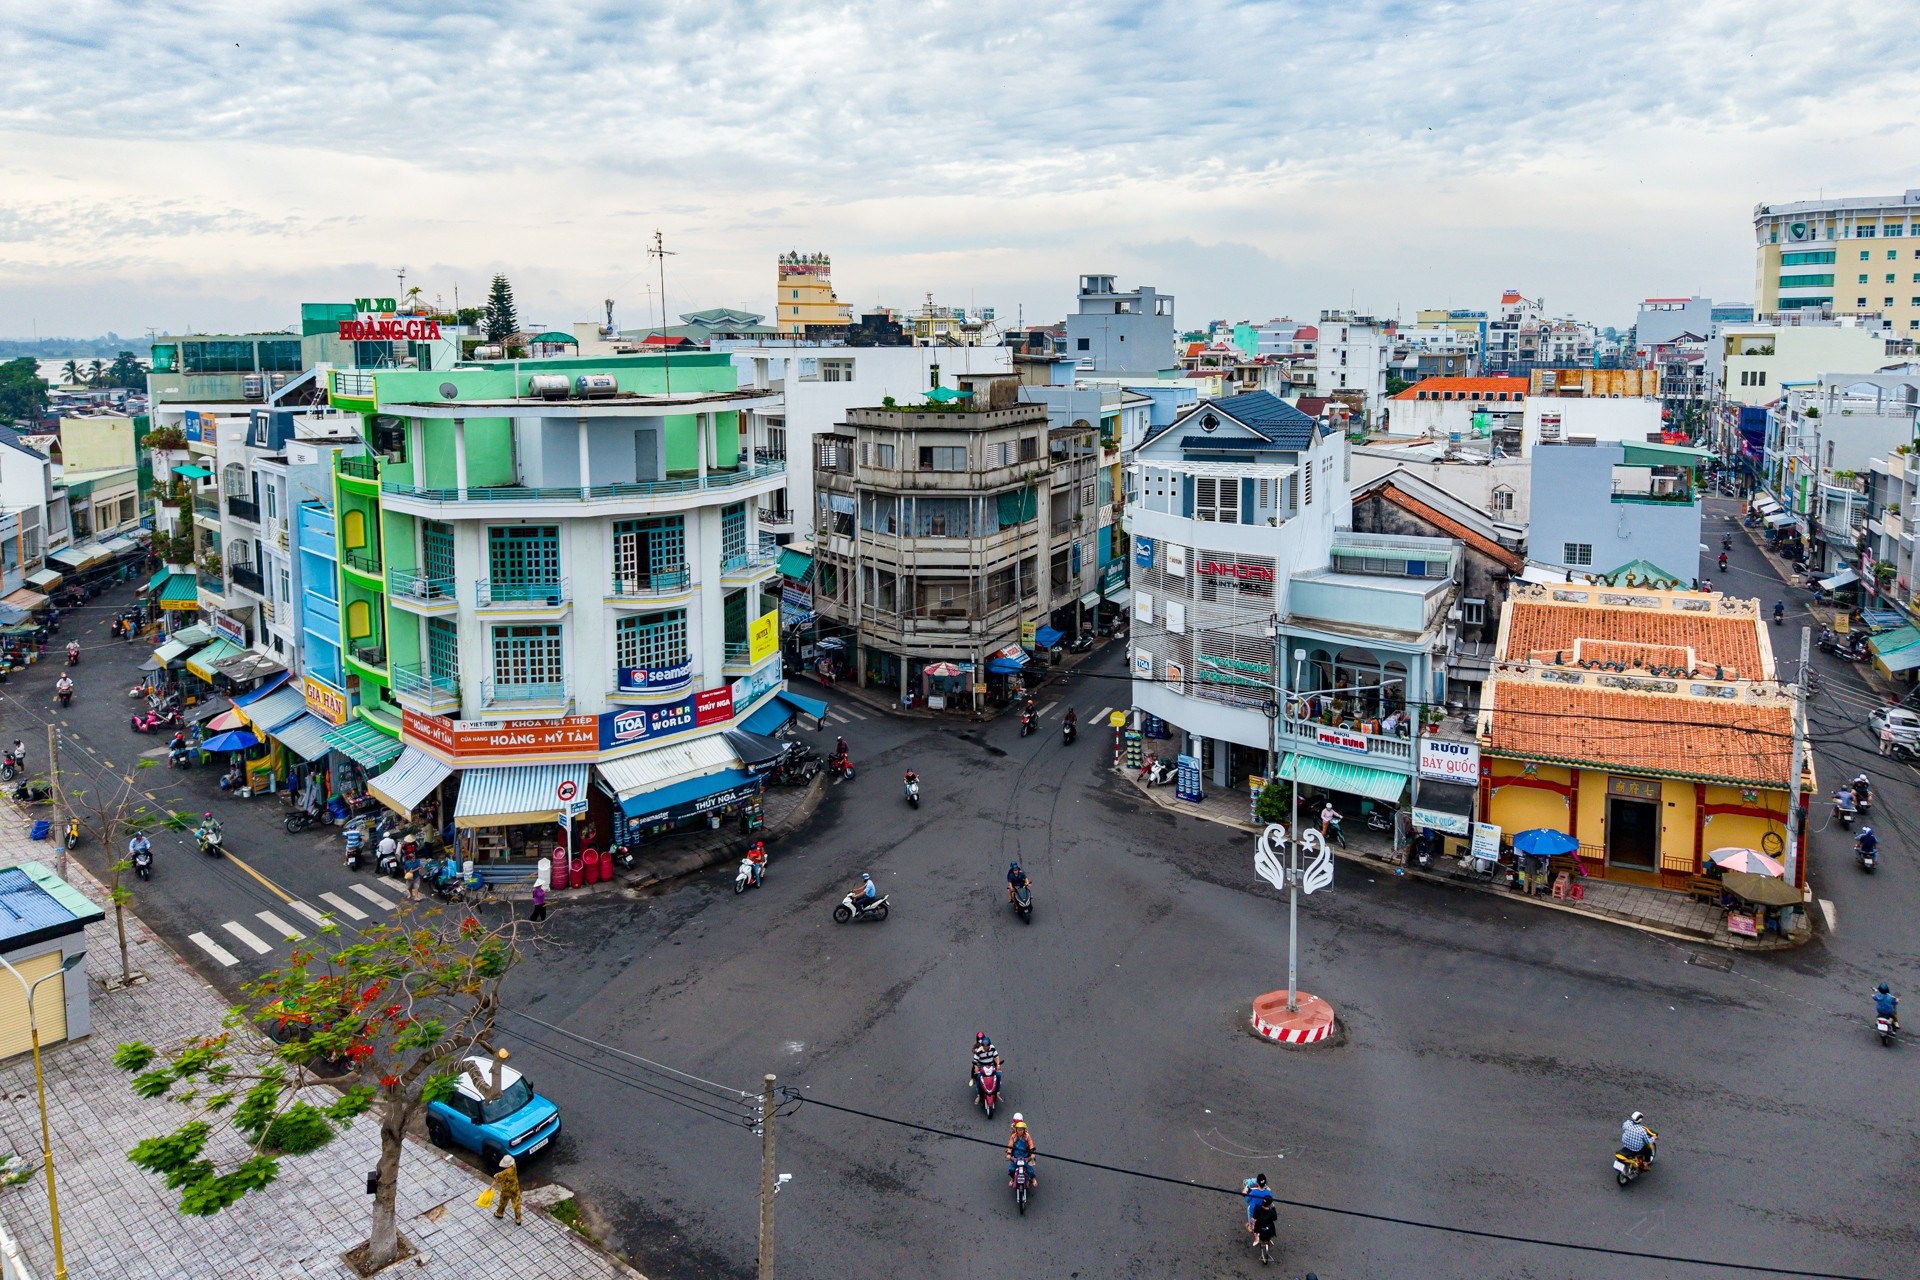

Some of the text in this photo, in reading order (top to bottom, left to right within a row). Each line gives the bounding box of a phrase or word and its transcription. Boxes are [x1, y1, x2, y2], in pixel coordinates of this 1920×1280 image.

[355, 298, 396, 312] VLXD
[339, 315, 441, 340] HOÀNG GIA
[307, 683, 323, 703] GIA
[716, 699, 731, 708] NGA
[651, 705, 691, 720] COLOR
[617, 718, 644, 733] TOA
[652, 714, 692, 731] WORLD
[490, 732, 536, 746] HOÀNG
[545, 730, 564, 743] MỸ
[566, 729, 593, 742] TÂM
[1319, 733, 1340, 745] PHỤC
[1430, 742, 1469, 756] RƯỢU
[1422, 754, 1476, 774] BẢY QUỐC
[717, 792, 737, 805] NGA
